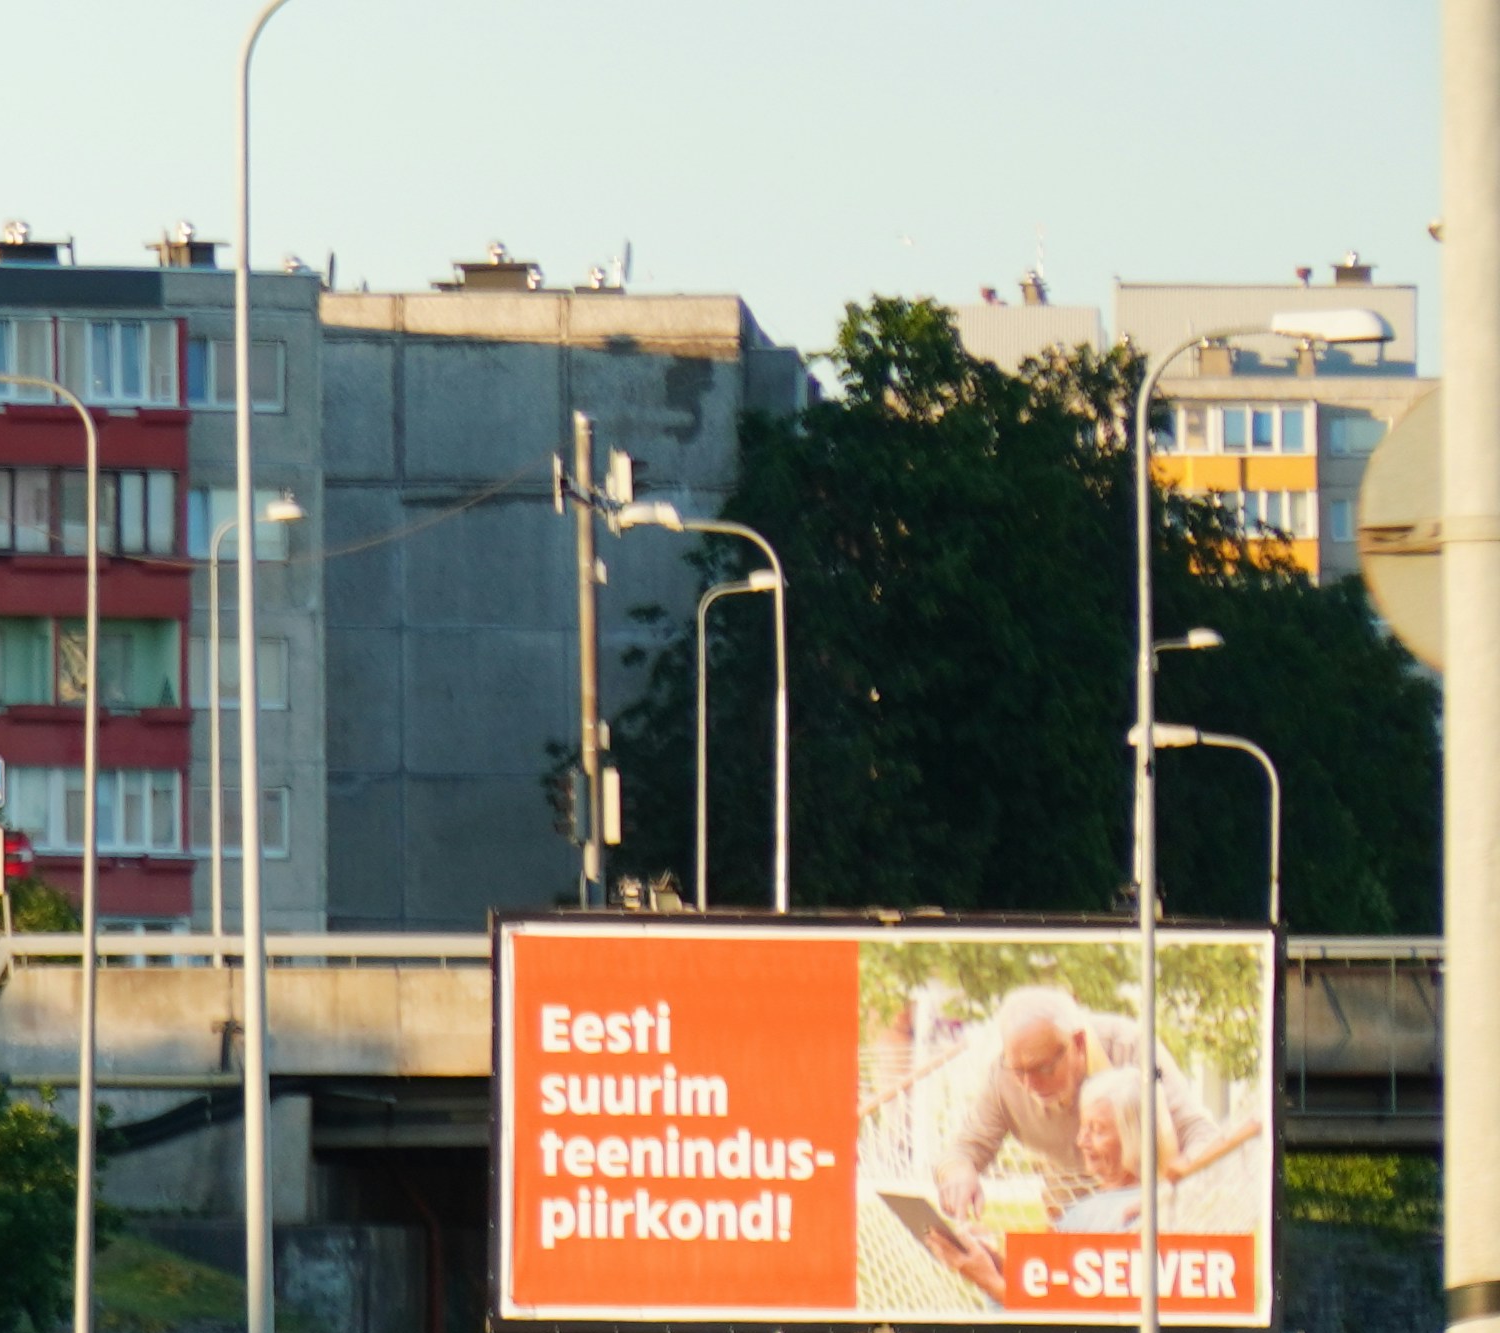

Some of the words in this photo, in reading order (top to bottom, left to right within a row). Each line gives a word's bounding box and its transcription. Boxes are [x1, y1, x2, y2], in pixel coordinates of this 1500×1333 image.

[540, 1001, 671, 1053] Eesti
[540, 1064, 728, 1116] suurim
[540, 1125, 836, 1180] teenindus-
[540, 1186, 793, 1249] piirkond!
